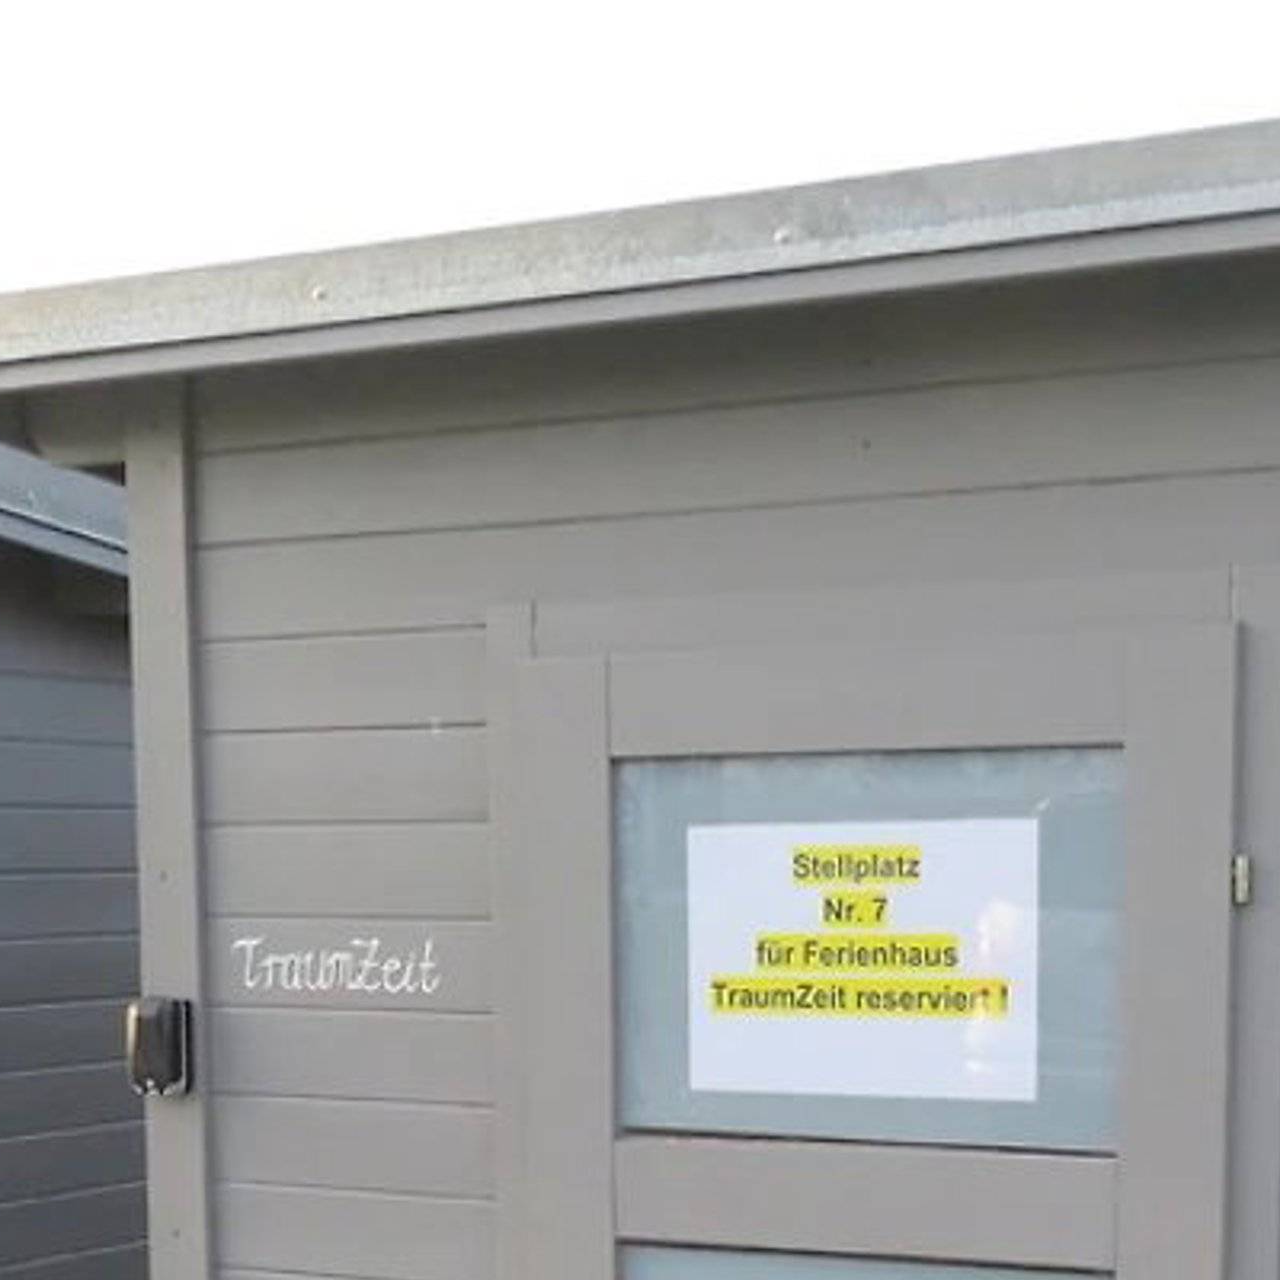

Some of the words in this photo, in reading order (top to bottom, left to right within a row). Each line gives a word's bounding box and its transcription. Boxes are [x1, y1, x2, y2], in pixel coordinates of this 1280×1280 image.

[793, 853, 920, 884] Stellplatz
[823, 898, 864, 922] Nr.
[873, 898, 888, 922] 7
[232, 935, 441, 993] TraumZeit
[756, 941, 793, 969] für
[803, 940, 959, 969] Ferienhaus
[713, 981, 847, 1010] TraumZeit
